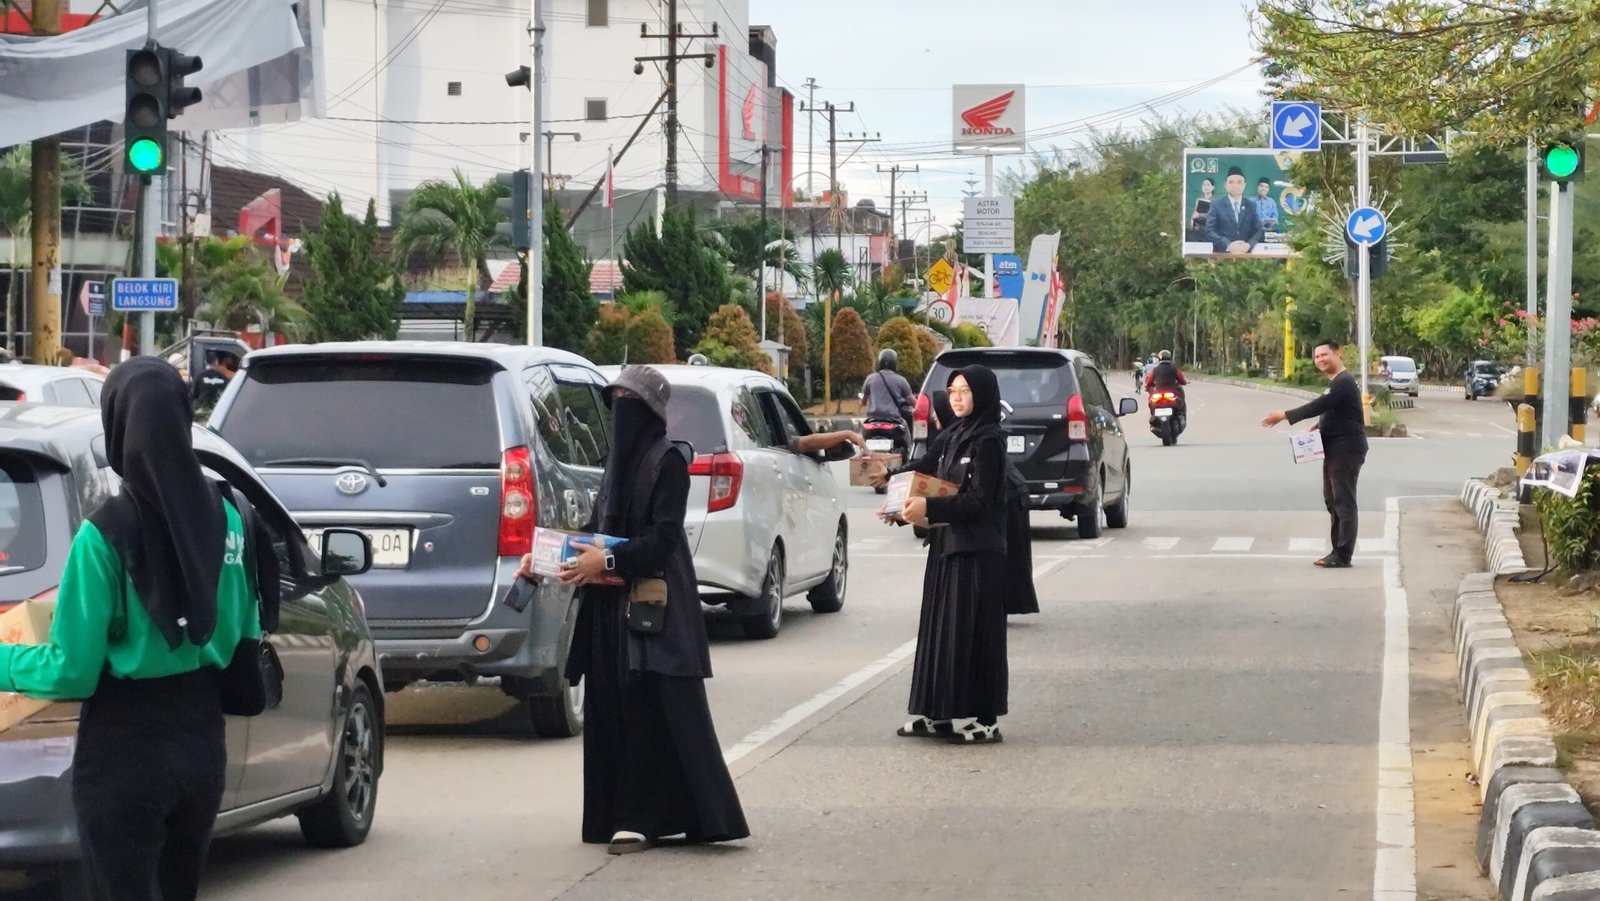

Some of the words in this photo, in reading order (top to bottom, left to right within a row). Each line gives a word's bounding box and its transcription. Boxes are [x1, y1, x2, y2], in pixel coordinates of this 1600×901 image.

[961, 127, 1016, 135] HONDA
[117, 283, 149, 294] BELOK
[152, 283, 173, 294] KIRI
[119, 295, 172, 306] LANGSUNG
